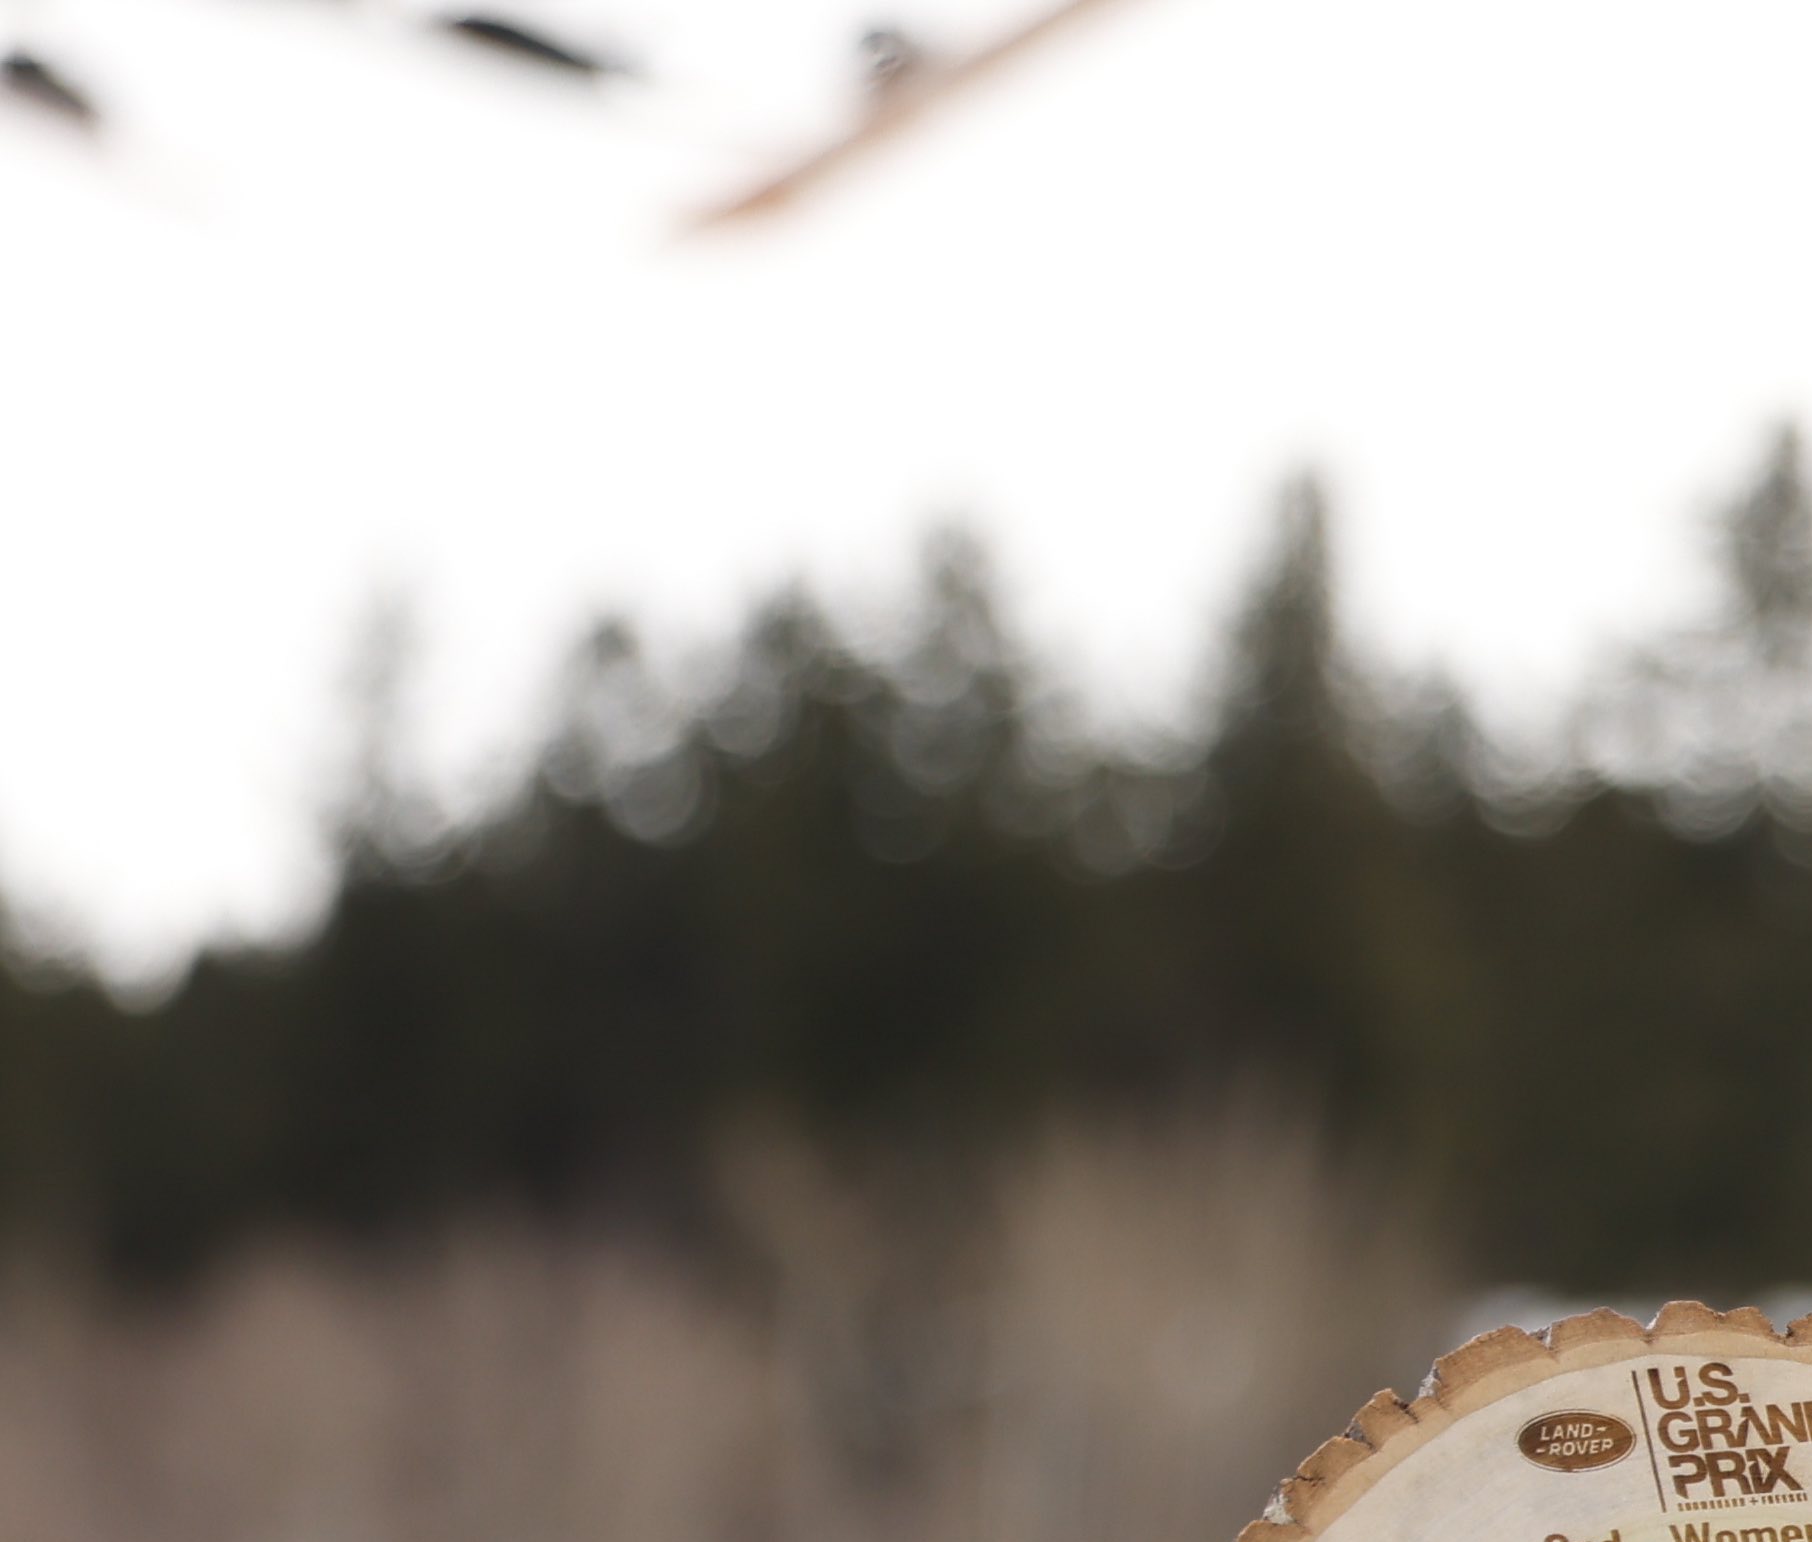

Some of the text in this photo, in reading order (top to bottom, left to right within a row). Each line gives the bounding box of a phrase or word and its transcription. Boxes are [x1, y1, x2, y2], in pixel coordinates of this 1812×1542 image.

[1647, 1362, 1750, 1410] U.S.
[1540, 1423, 1594, 1440] LAND
[1548, 1439, 1615, 1457] ROVER
[1668, 1446, 1805, 1500] PRIX
